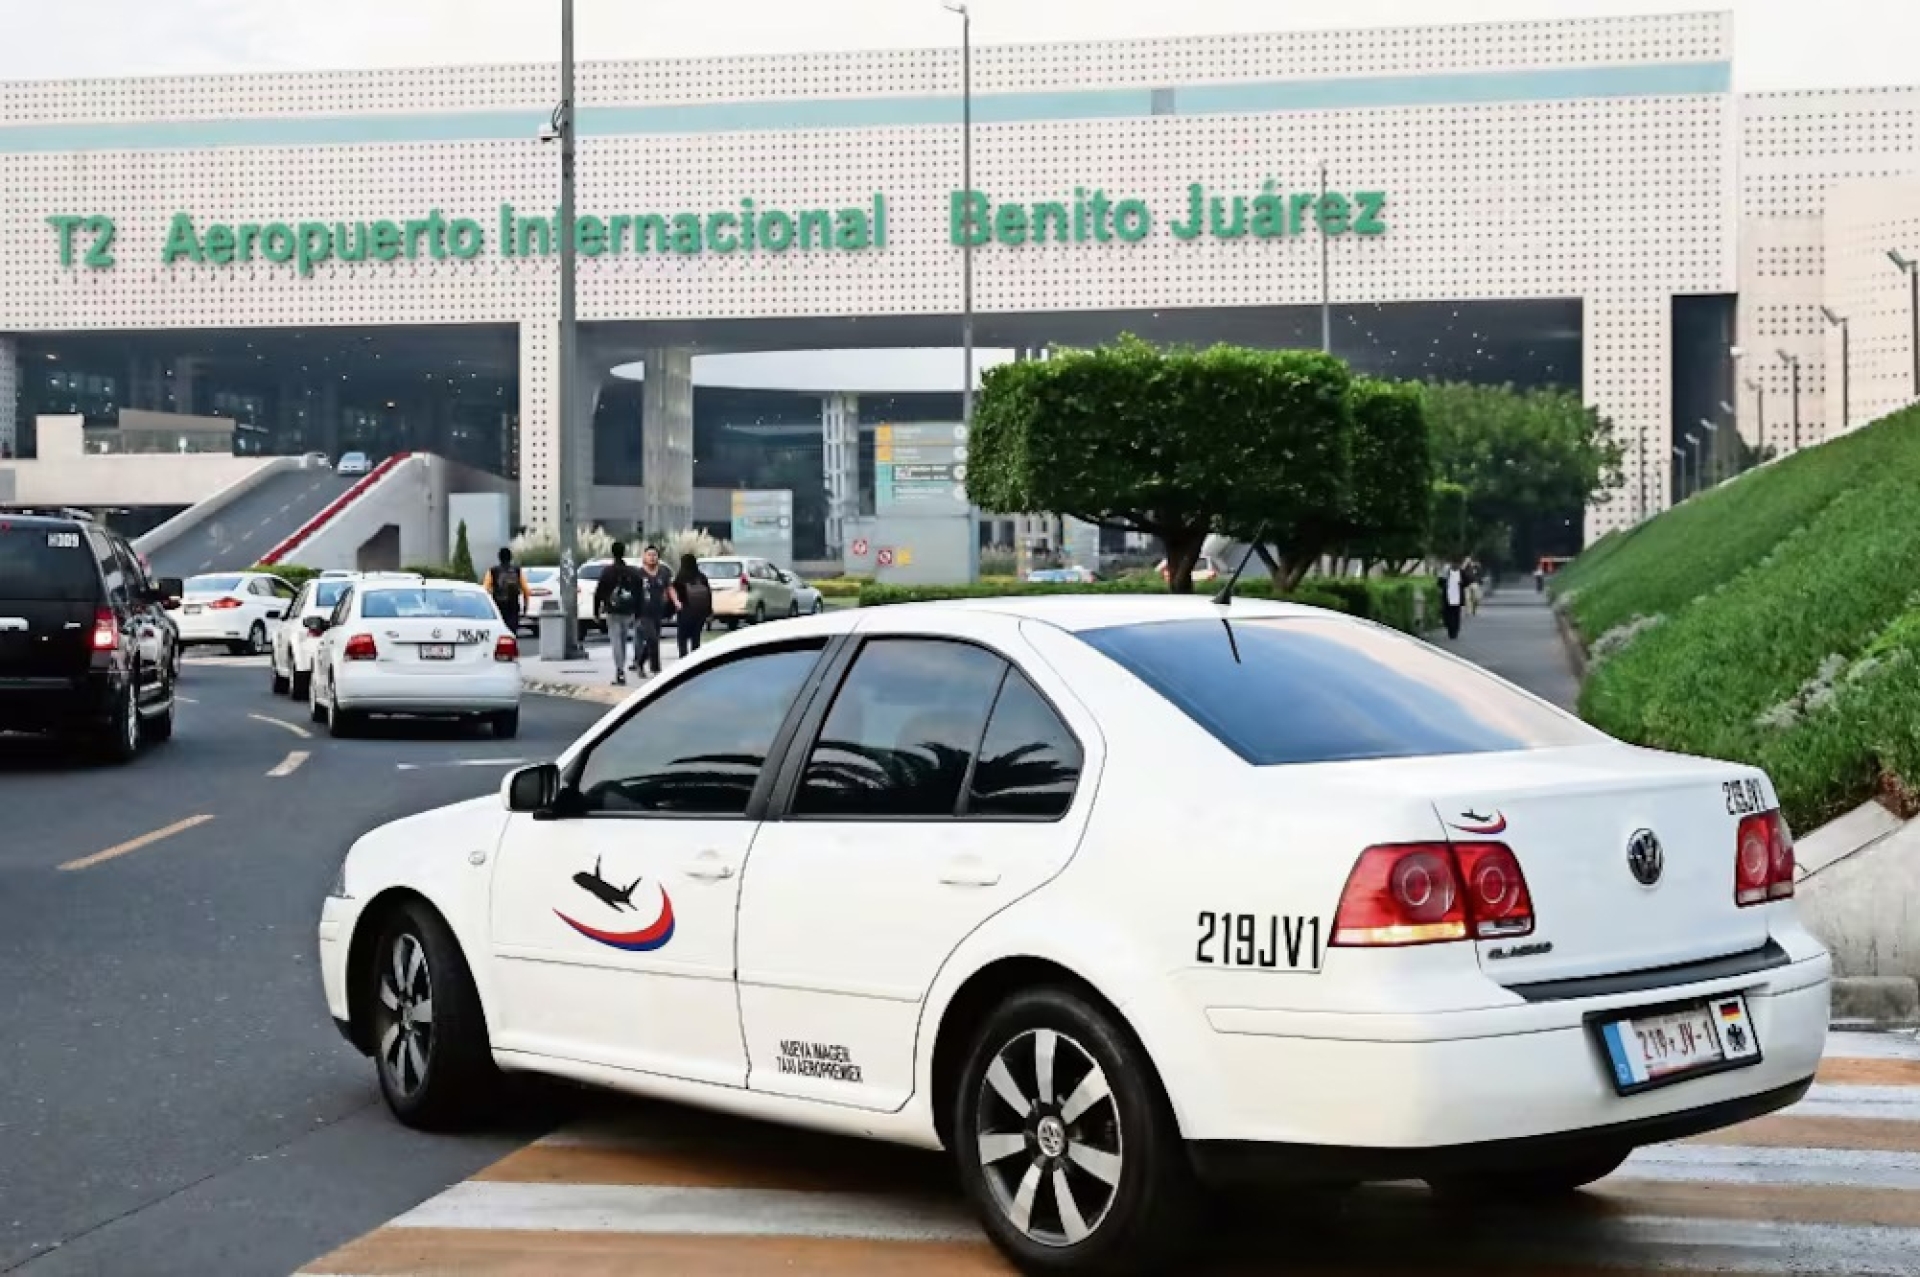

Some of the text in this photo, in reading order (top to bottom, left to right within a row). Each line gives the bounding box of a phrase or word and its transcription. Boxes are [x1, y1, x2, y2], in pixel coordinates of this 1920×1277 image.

[46, 214, 116, 268] T2
[162, 211, 484, 277] Aeropuerto
[949, 186, 1151, 246] Benito
[1170, 179, 1387, 240] Juárez
[1196, 910, 1321, 969] 219JV1
